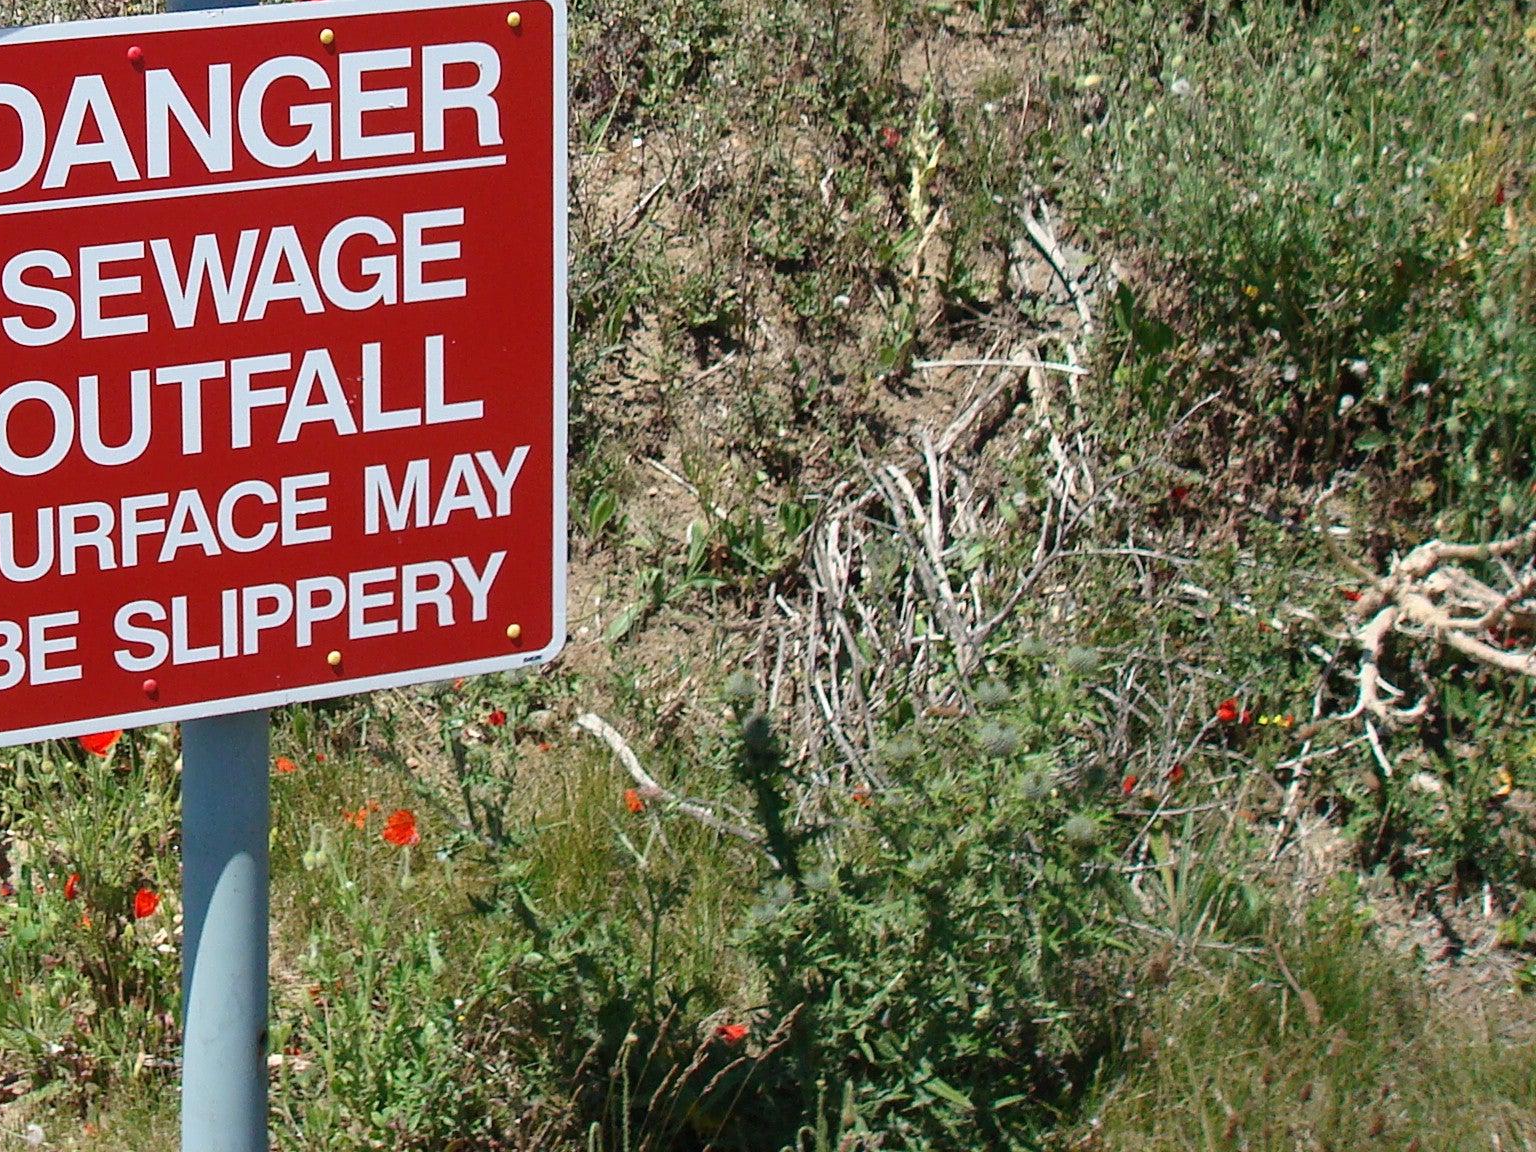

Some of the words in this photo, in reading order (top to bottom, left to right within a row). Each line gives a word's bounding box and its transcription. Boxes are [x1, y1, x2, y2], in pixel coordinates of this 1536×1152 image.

[1, 207, 467, 347] SEWAGE
[364, 445, 531, 535] MAY
[113, 550, 507, 672] SLIPPERY
